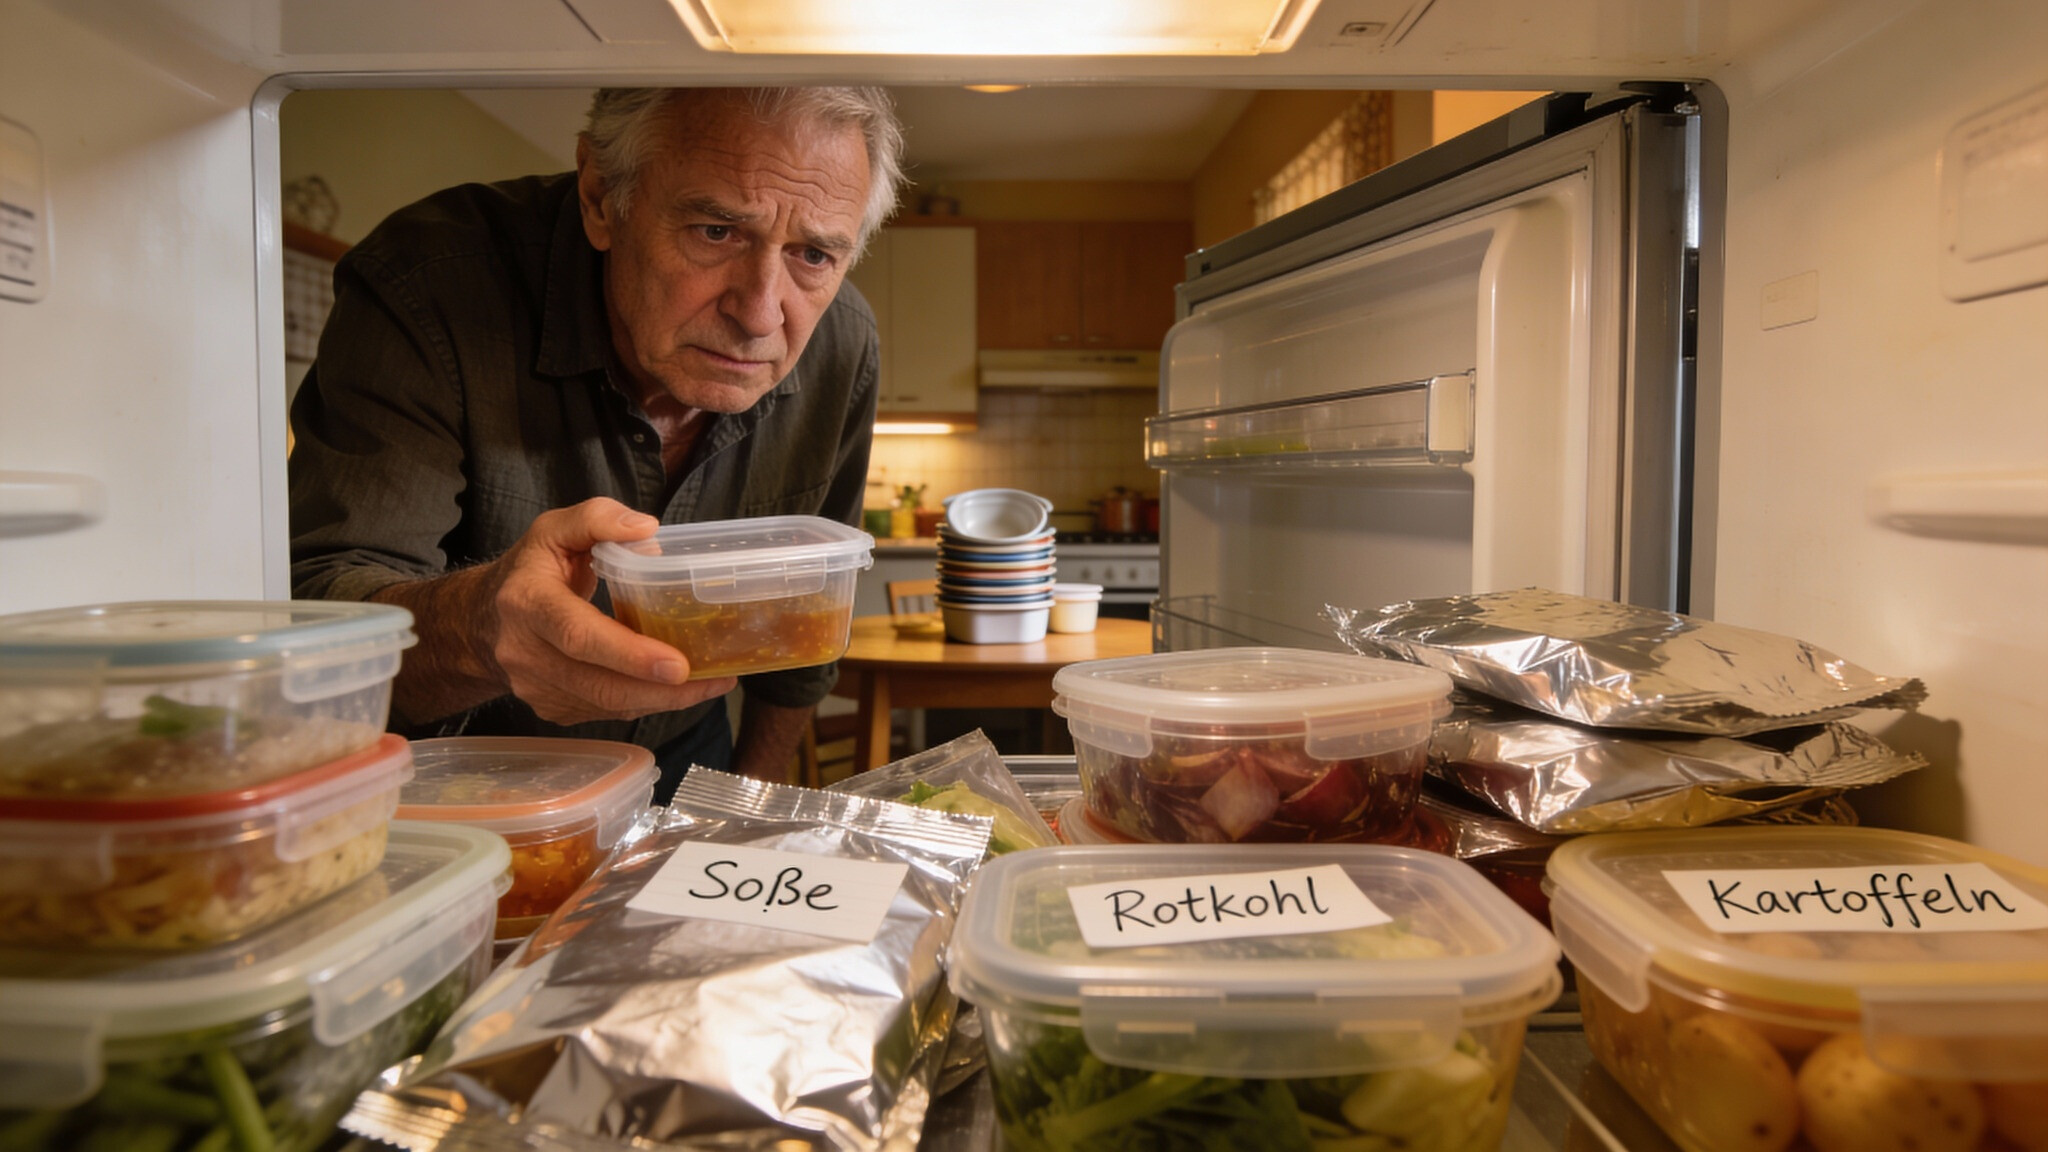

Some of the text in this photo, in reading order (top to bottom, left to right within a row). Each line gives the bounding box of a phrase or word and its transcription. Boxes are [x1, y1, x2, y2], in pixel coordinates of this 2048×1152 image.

[688, 860, 839, 912] Soße
[1104, 876, 1329, 932] Rotkohl
[1708, 873, 2016, 929] Kartoffeln
